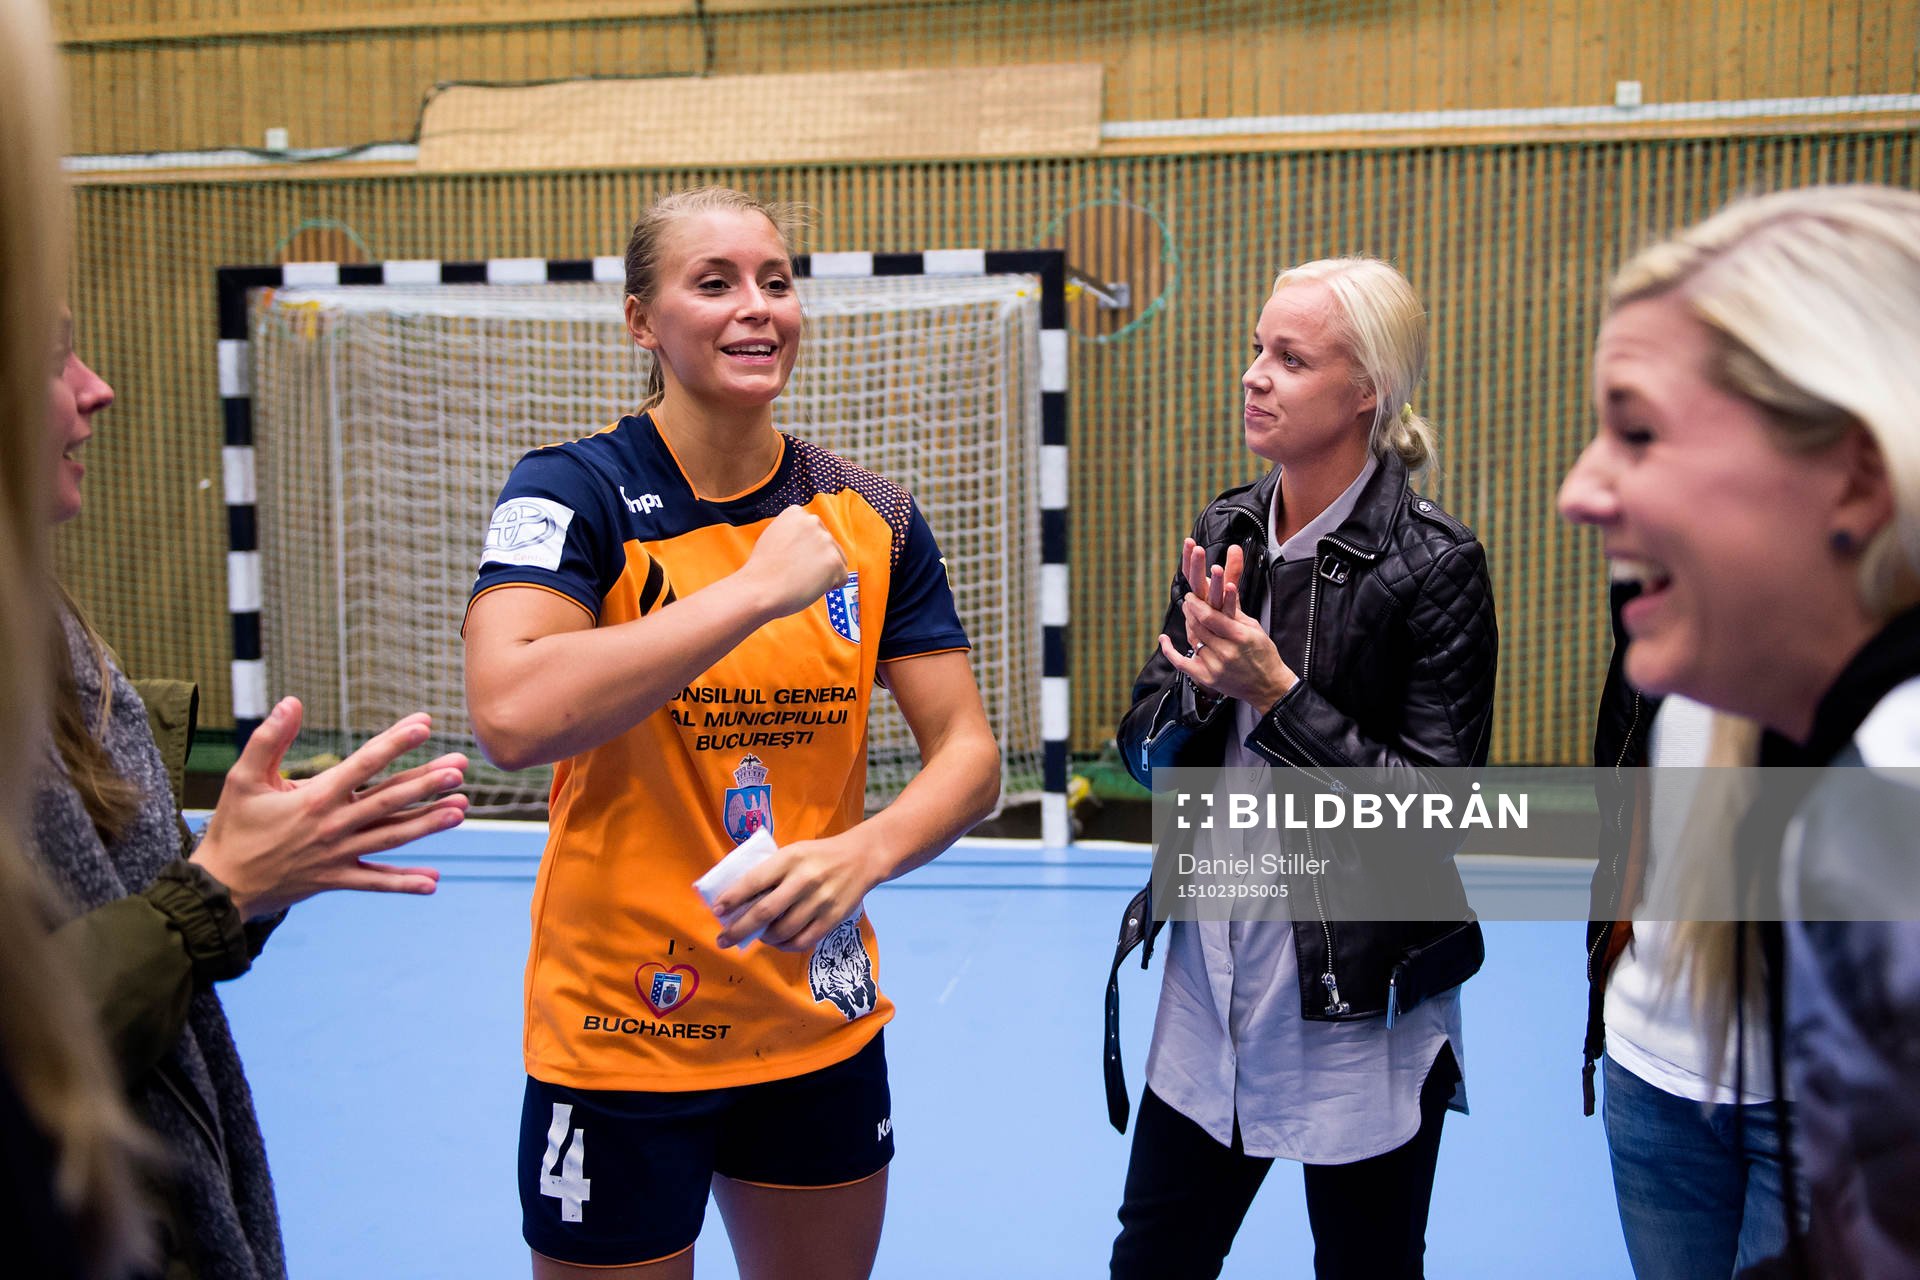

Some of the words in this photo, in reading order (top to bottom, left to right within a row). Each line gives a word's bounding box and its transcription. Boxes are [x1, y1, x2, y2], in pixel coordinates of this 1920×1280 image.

[672, 687, 767, 705] NSILIUL
[773, 687, 857, 705] GENERA
[671, 709, 696, 727] AL
[704, 710, 848, 727] MUNICIPIULUI
[668, 939, 675, 955] I
[583, 1015, 731, 1040] BUCHAREST
[540, 1102, 591, 1223] 4
